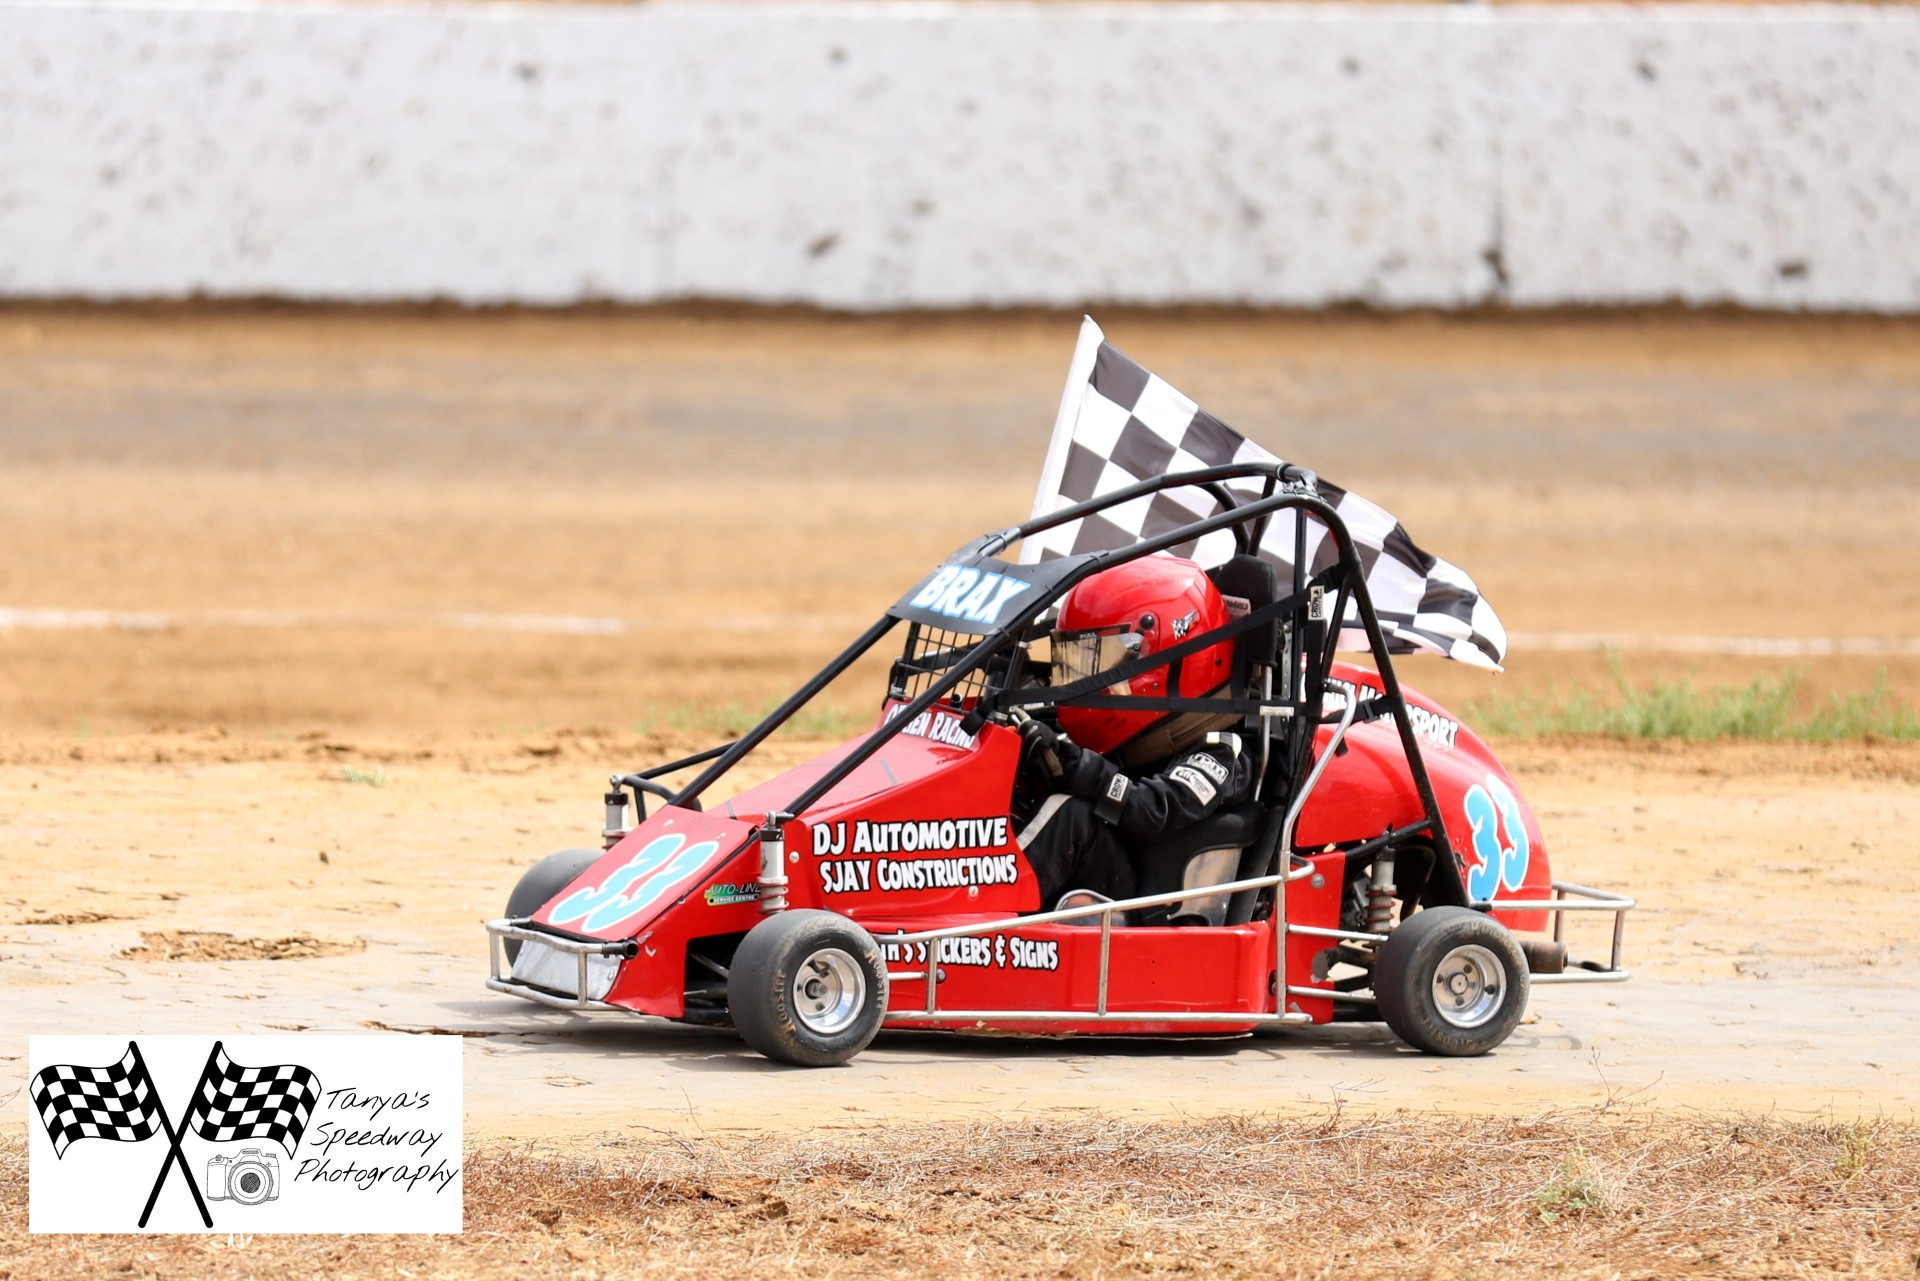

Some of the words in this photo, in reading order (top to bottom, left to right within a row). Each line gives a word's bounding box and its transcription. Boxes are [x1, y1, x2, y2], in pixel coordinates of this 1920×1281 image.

[909, 564, 1031, 624] BRAX
[812, 821, 847, 856] DJ
[851, 816, 1009, 854] AUTOMOTIVE
[1463, 773, 1530, 902] 33
[547, 833, 719, 933] 33
[818, 858, 872, 894] SJAY
[875, 852, 1018, 892] CONSTRUCTIONS
[994, 934, 1008, 968] &
[1009, 936, 1060, 971] SIGNS
